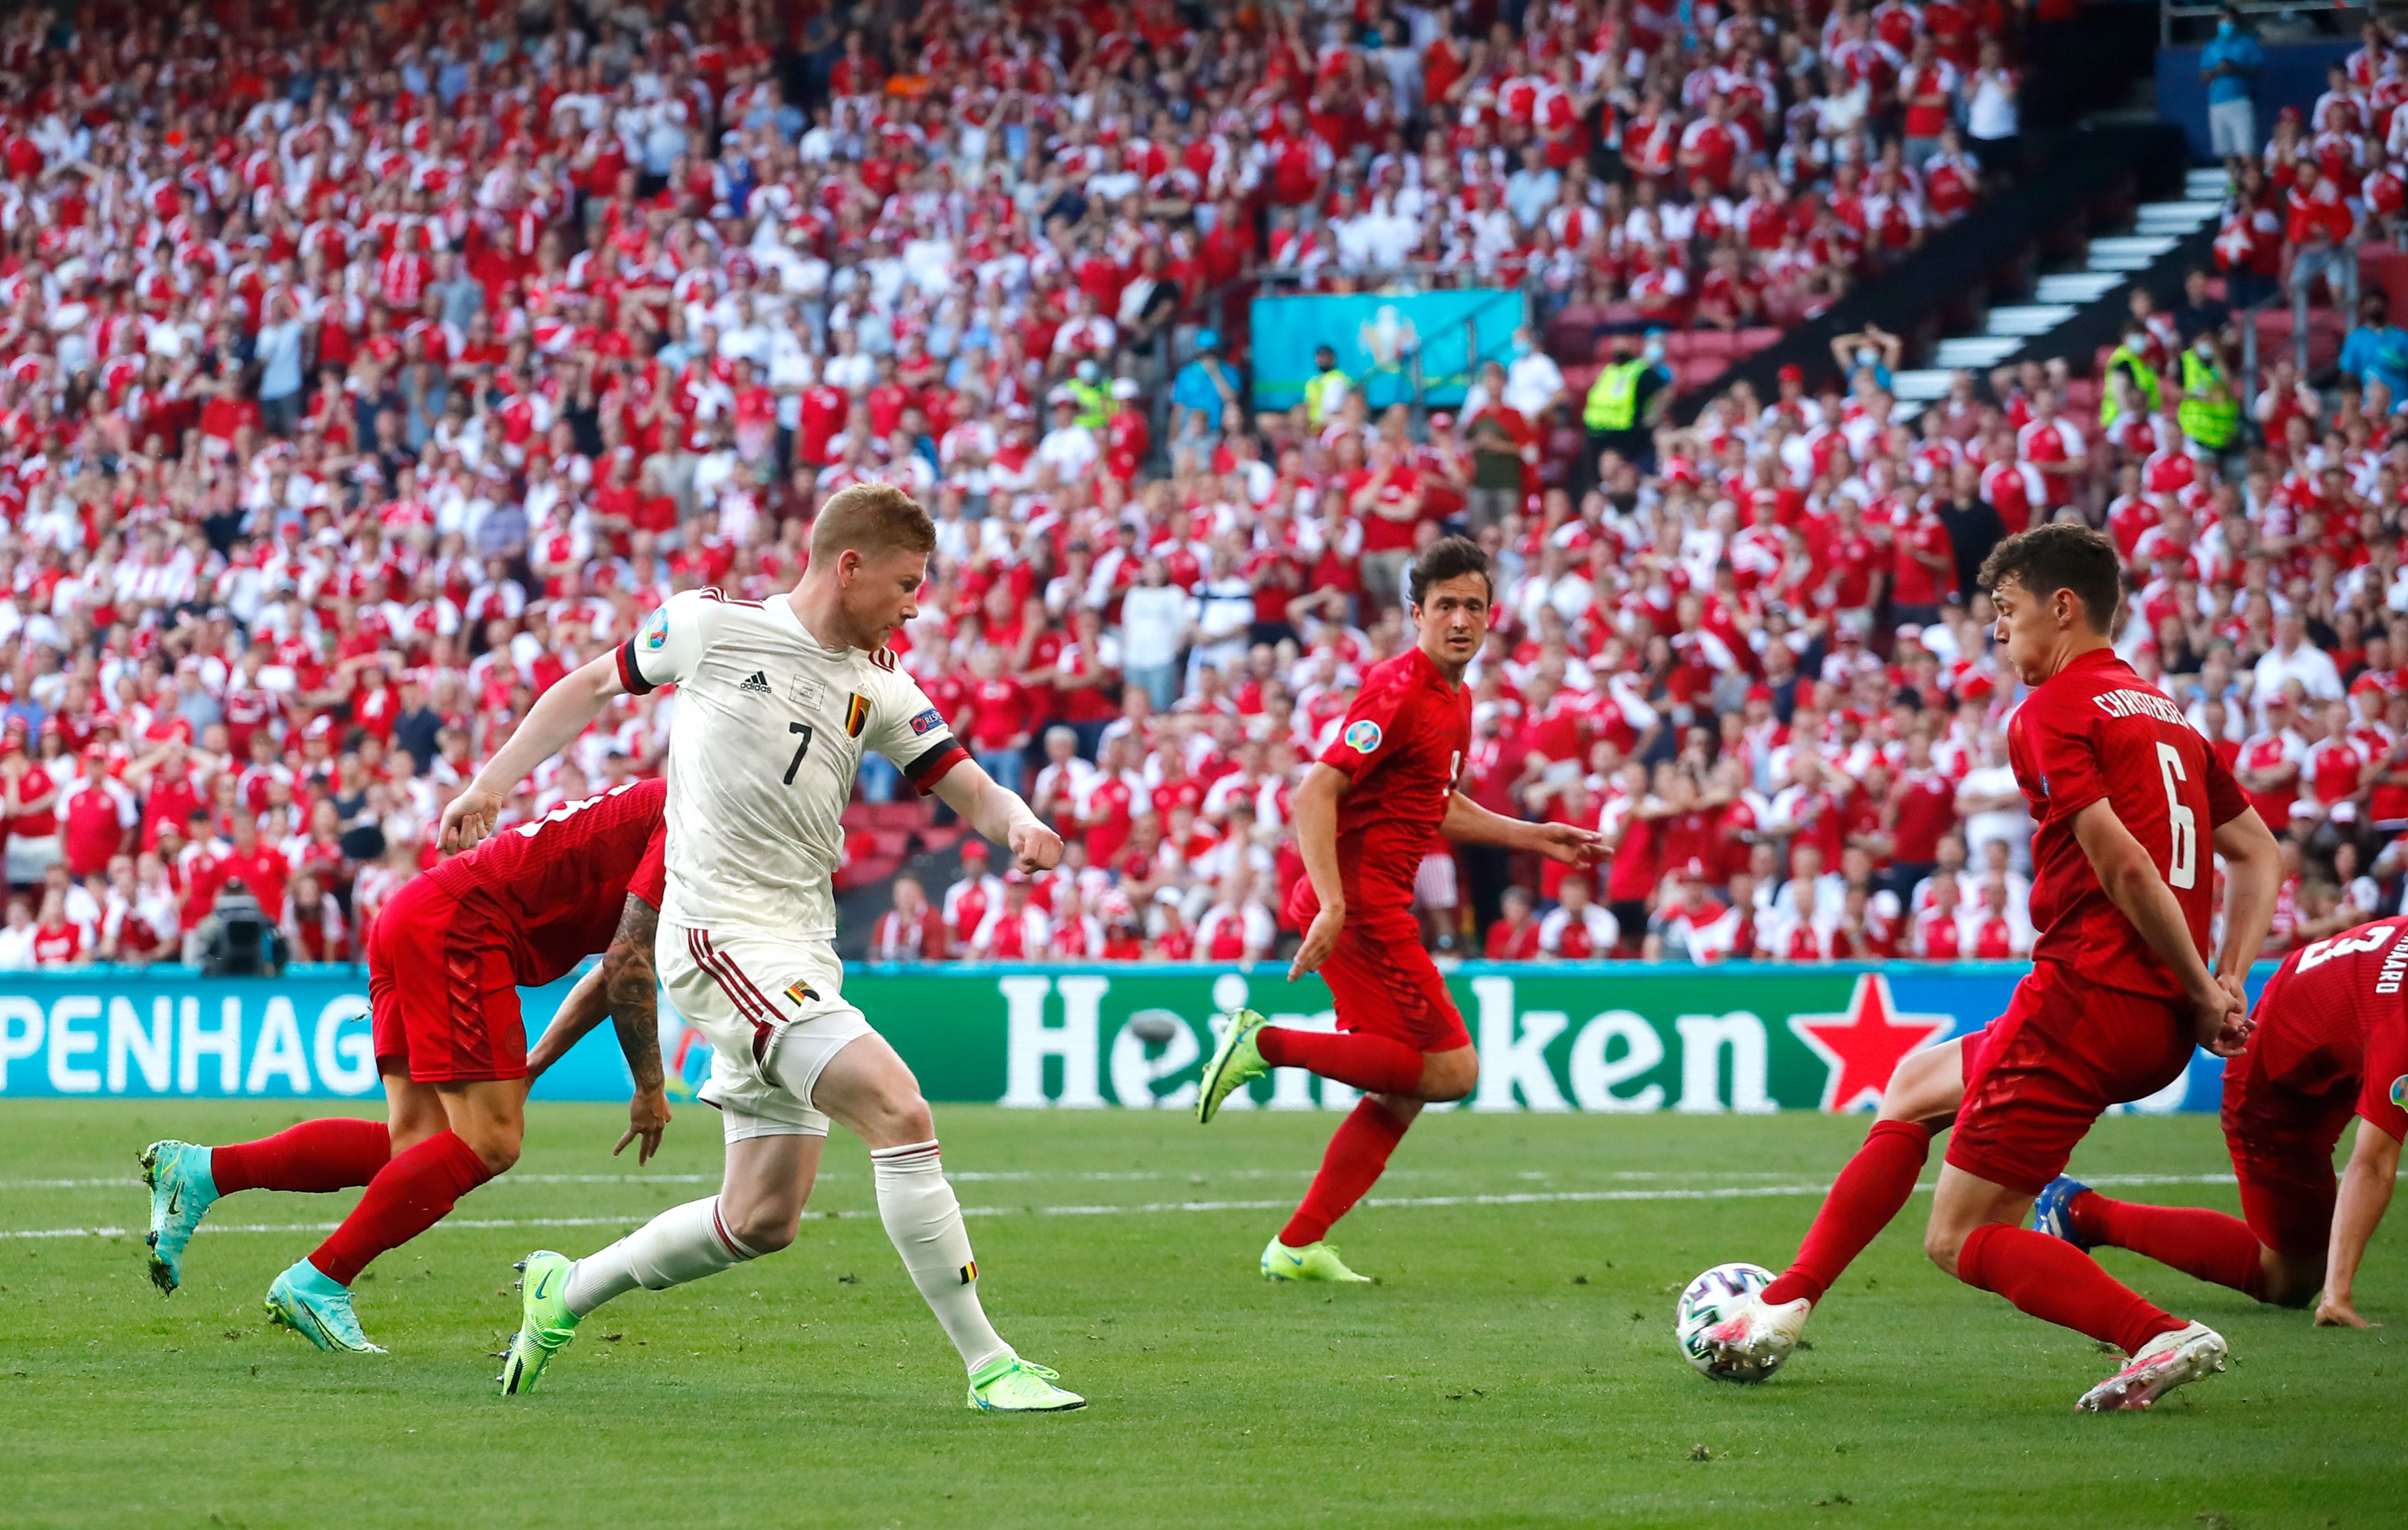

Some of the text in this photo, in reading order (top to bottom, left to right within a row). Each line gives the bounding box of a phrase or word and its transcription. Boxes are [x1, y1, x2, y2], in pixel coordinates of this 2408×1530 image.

[740, 682, 772, 694] adidas
[783, 722, 812, 785] 7
[2156, 741, 2196, 890] 6
[2295, 925, 2396, 975] 3
[998, 973, 1780, 1113] Heinken
